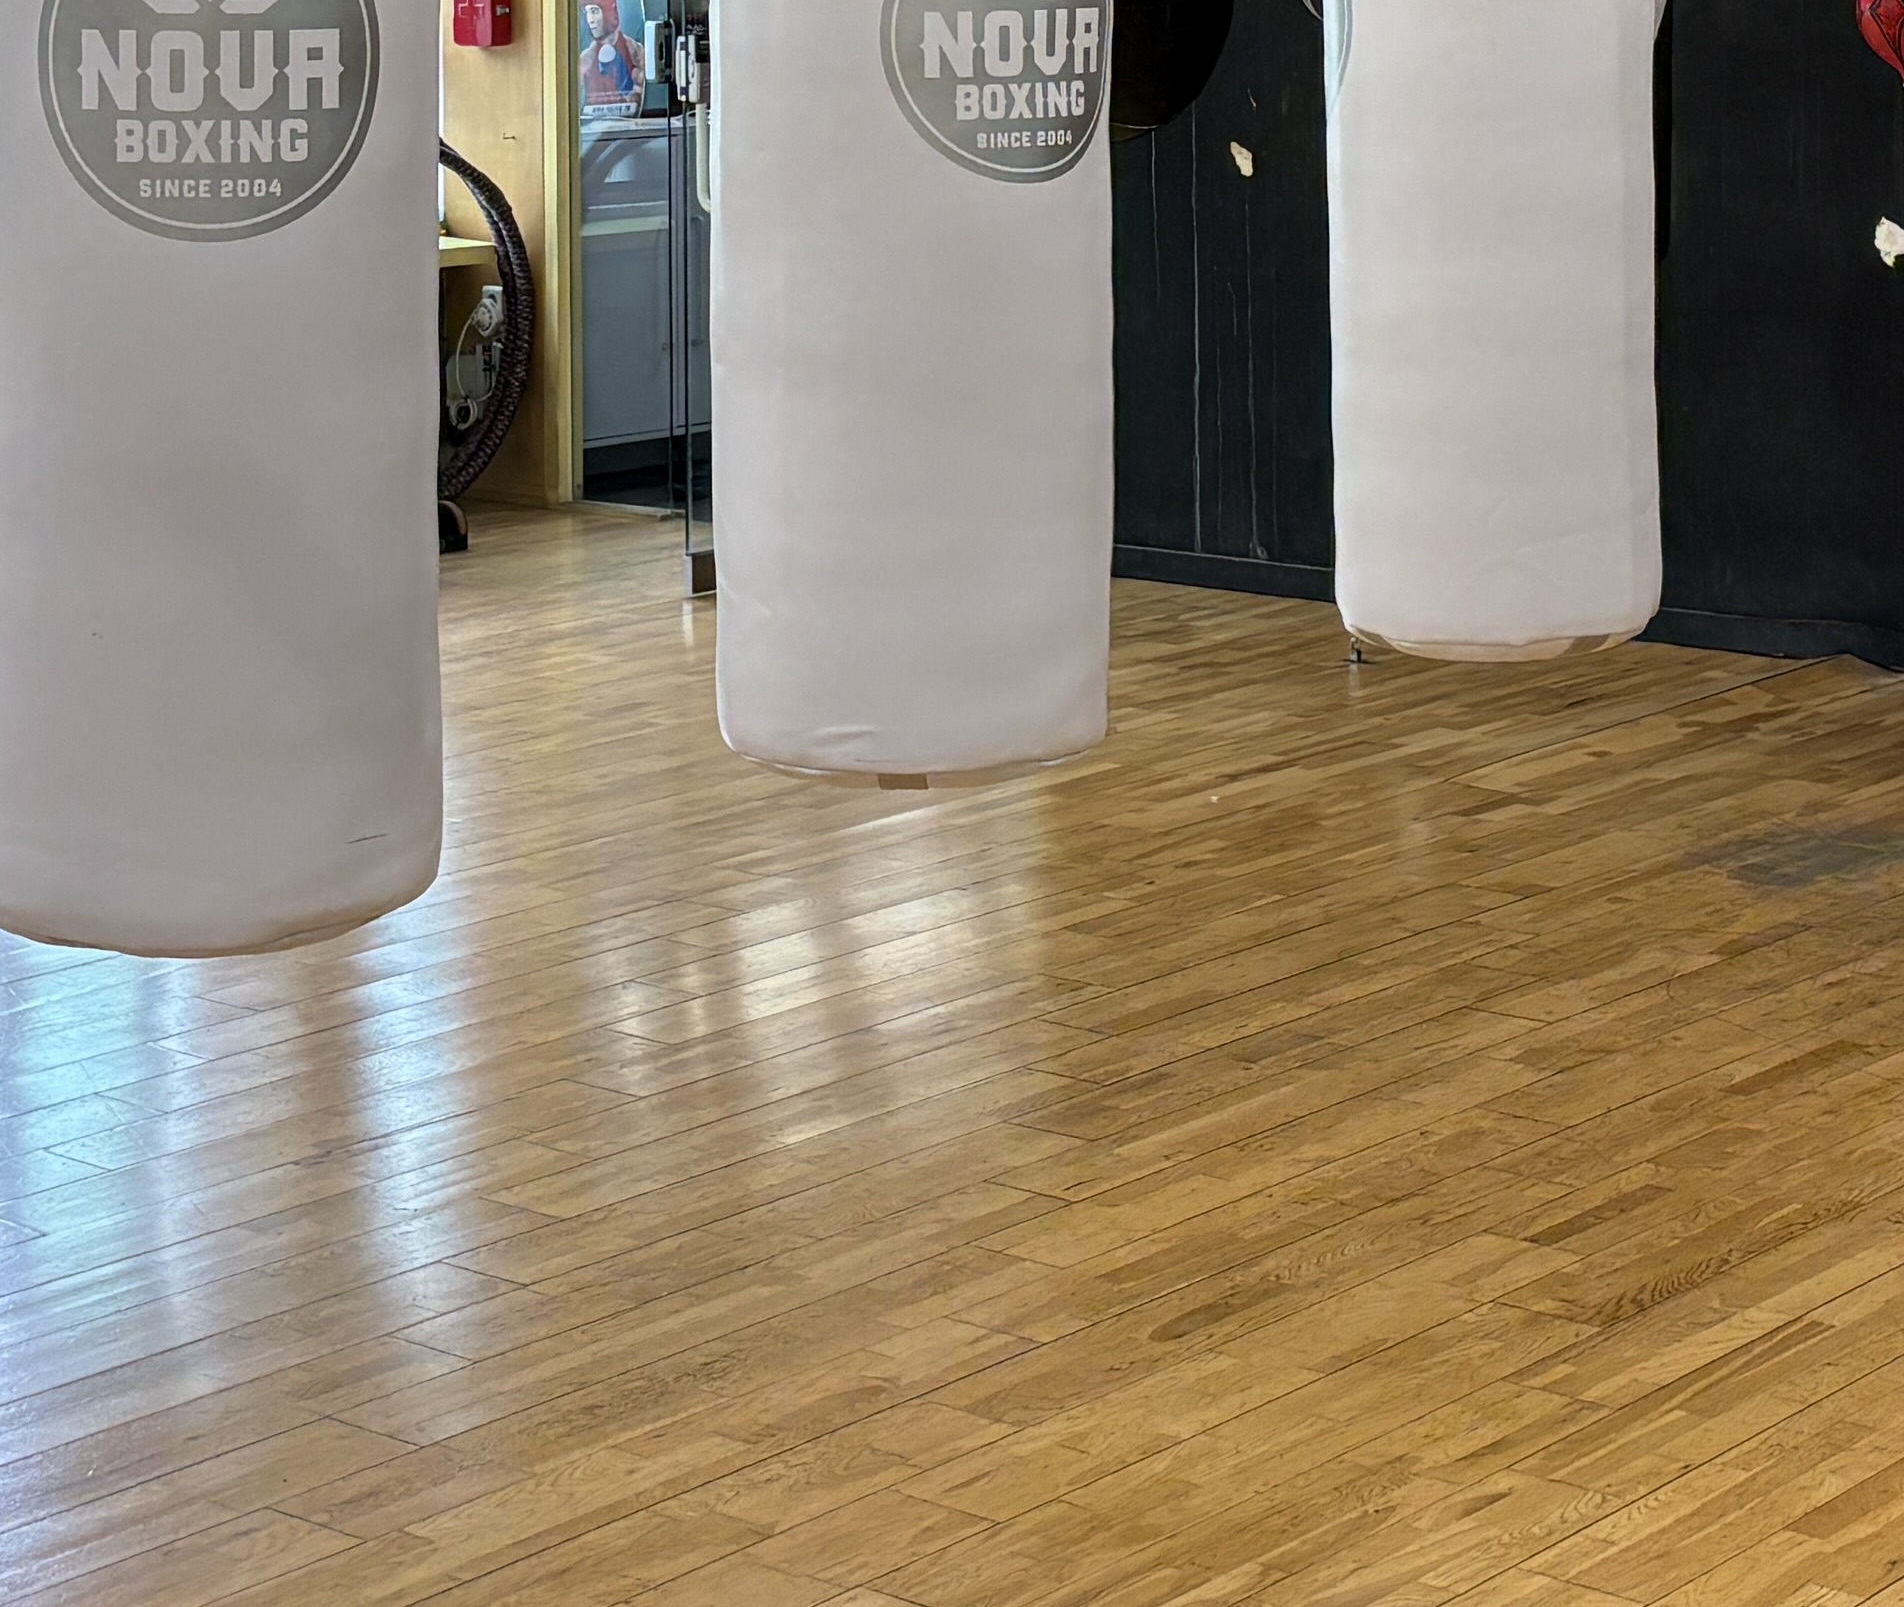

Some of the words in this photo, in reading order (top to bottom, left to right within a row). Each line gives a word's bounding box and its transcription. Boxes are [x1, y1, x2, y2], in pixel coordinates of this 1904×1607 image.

[920, 7, 1100, 78] NOVA
[77, 28, 345, 112] NOVA
[955, 80, 1085, 121] BOXING
[114, 119, 309, 163] BOXING
[976, 131, 1032, 149] SINCE
[1036, 129, 1073, 146] 2004
[139, 179, 212, 198] SINCE
[220, 178, 282, 198] 2004
